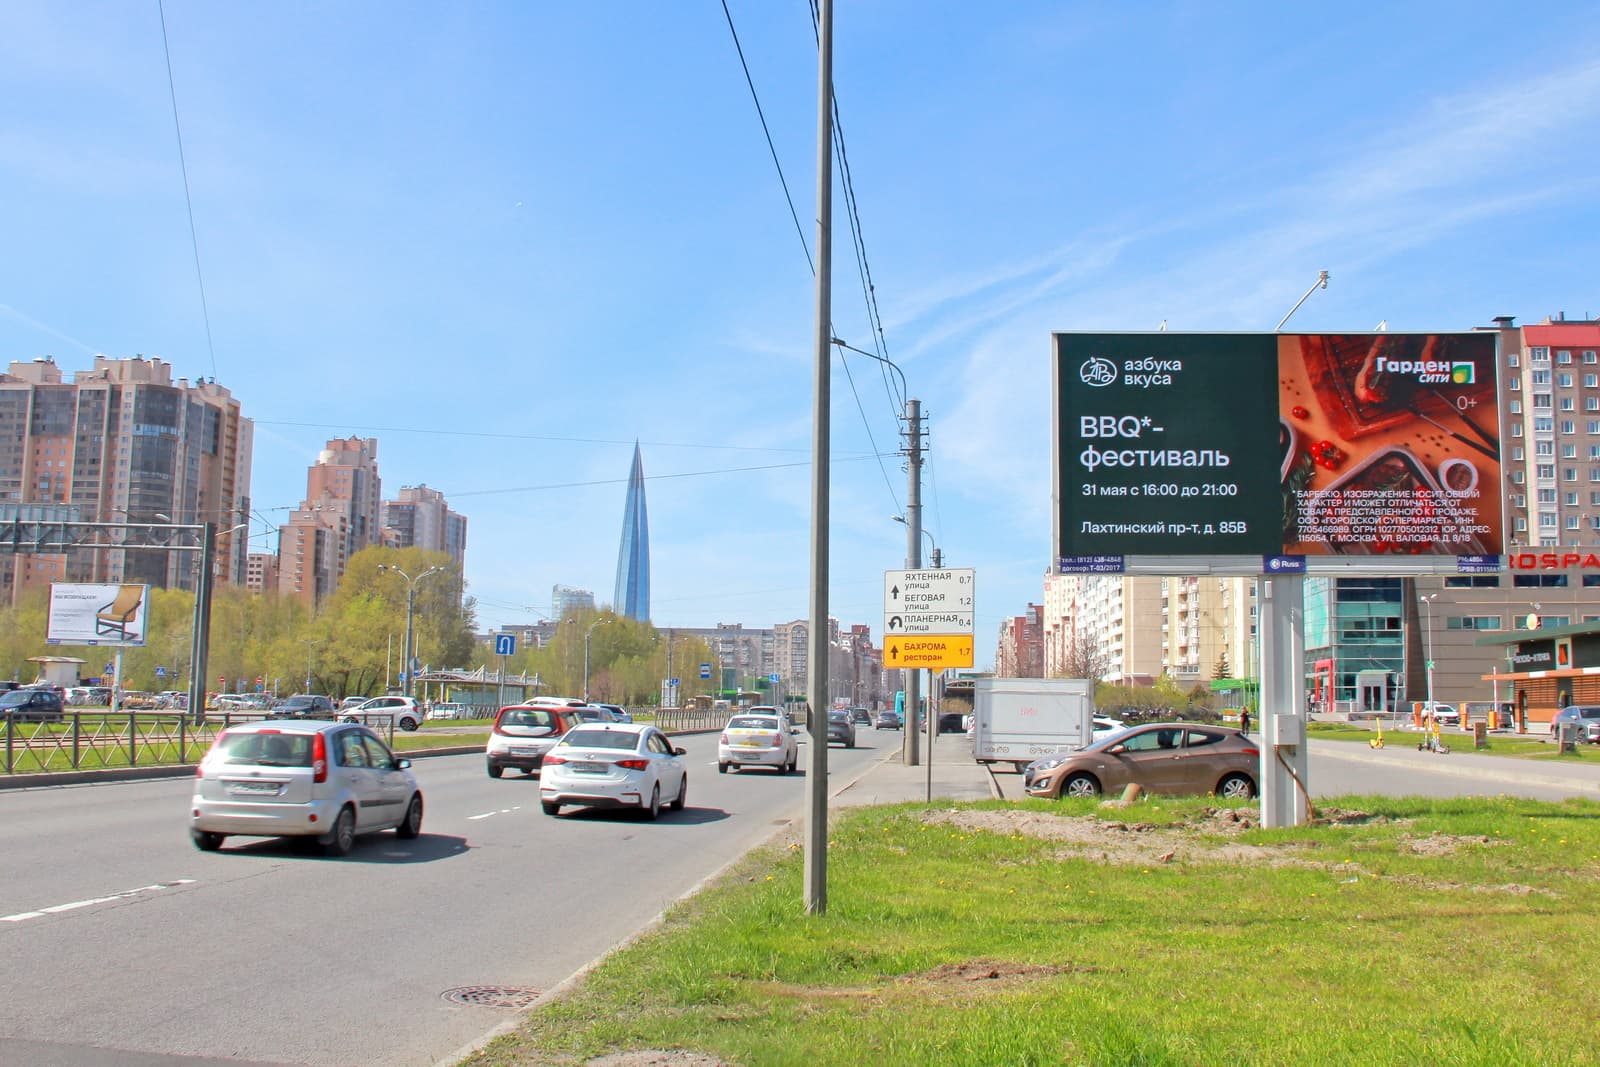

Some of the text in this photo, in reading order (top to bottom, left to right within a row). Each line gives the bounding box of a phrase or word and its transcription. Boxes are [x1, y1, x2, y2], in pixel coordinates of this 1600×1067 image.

[1124, 356, 1182, 374] азбука
[1376, 357, 1450, 374] Гарден
[1124, 374, 1172, 388] вкуса
[1456, 395, 1478, 410] 0+
[1080, 445, 1231, 472] фестиваль
[1082, 484, 1238, 497] 31 мая с 16:00 до 21:00
[1343, 490, 1410, 498] ИЗОБРАЖЕНИЕ
[1412, 490, 1444, 498] НОСИТ
[1446, 489, 1480, 498] ОБЩИЙ
[1297, 499, 1460, 507] ХАРАКТЕР И МОЖЕТ ОТЛИЧАТЬСЯ ОТ
[1334, 508, 1423, 516] ПРЕДСТАВЛЕННОГО
[1297, 516, 1319, 524] ООО
[1321, 515, 1381, 524] «ГОРОДСКОЙ
[1081, 521, 1164, 534] Лахтинский
[1203, 524, 1216, 534] д.
[1219, 521, 1247, 534] 85В
[1352, 525, 1377, 533] ОГРН
[1441, 525, 1458, 533] ЮР.
[1460, 525, 1491, 534] АДРЕС:
[1281, 560, 1300, 568] Russ
[905, 572, 952, 581] ЯХТЕННАЯ
[959, 576, 971, 584] 0,7
[904, 583, 930, 591] улица
[904, 594, 945, 602] БЕГОВАЯ
[960, 597, 971, 606] 1,2
[904, 603, 930, 611] улица
[904, 614, 958, 623] ПЛАНЕРНАЯ
[958, 619, 971, 627] 0,4
[904, 642, 947, 651] БАХРОМА
[959, 648, 971, 656] 1,7
[903, 654, 943, 662] ресторан
